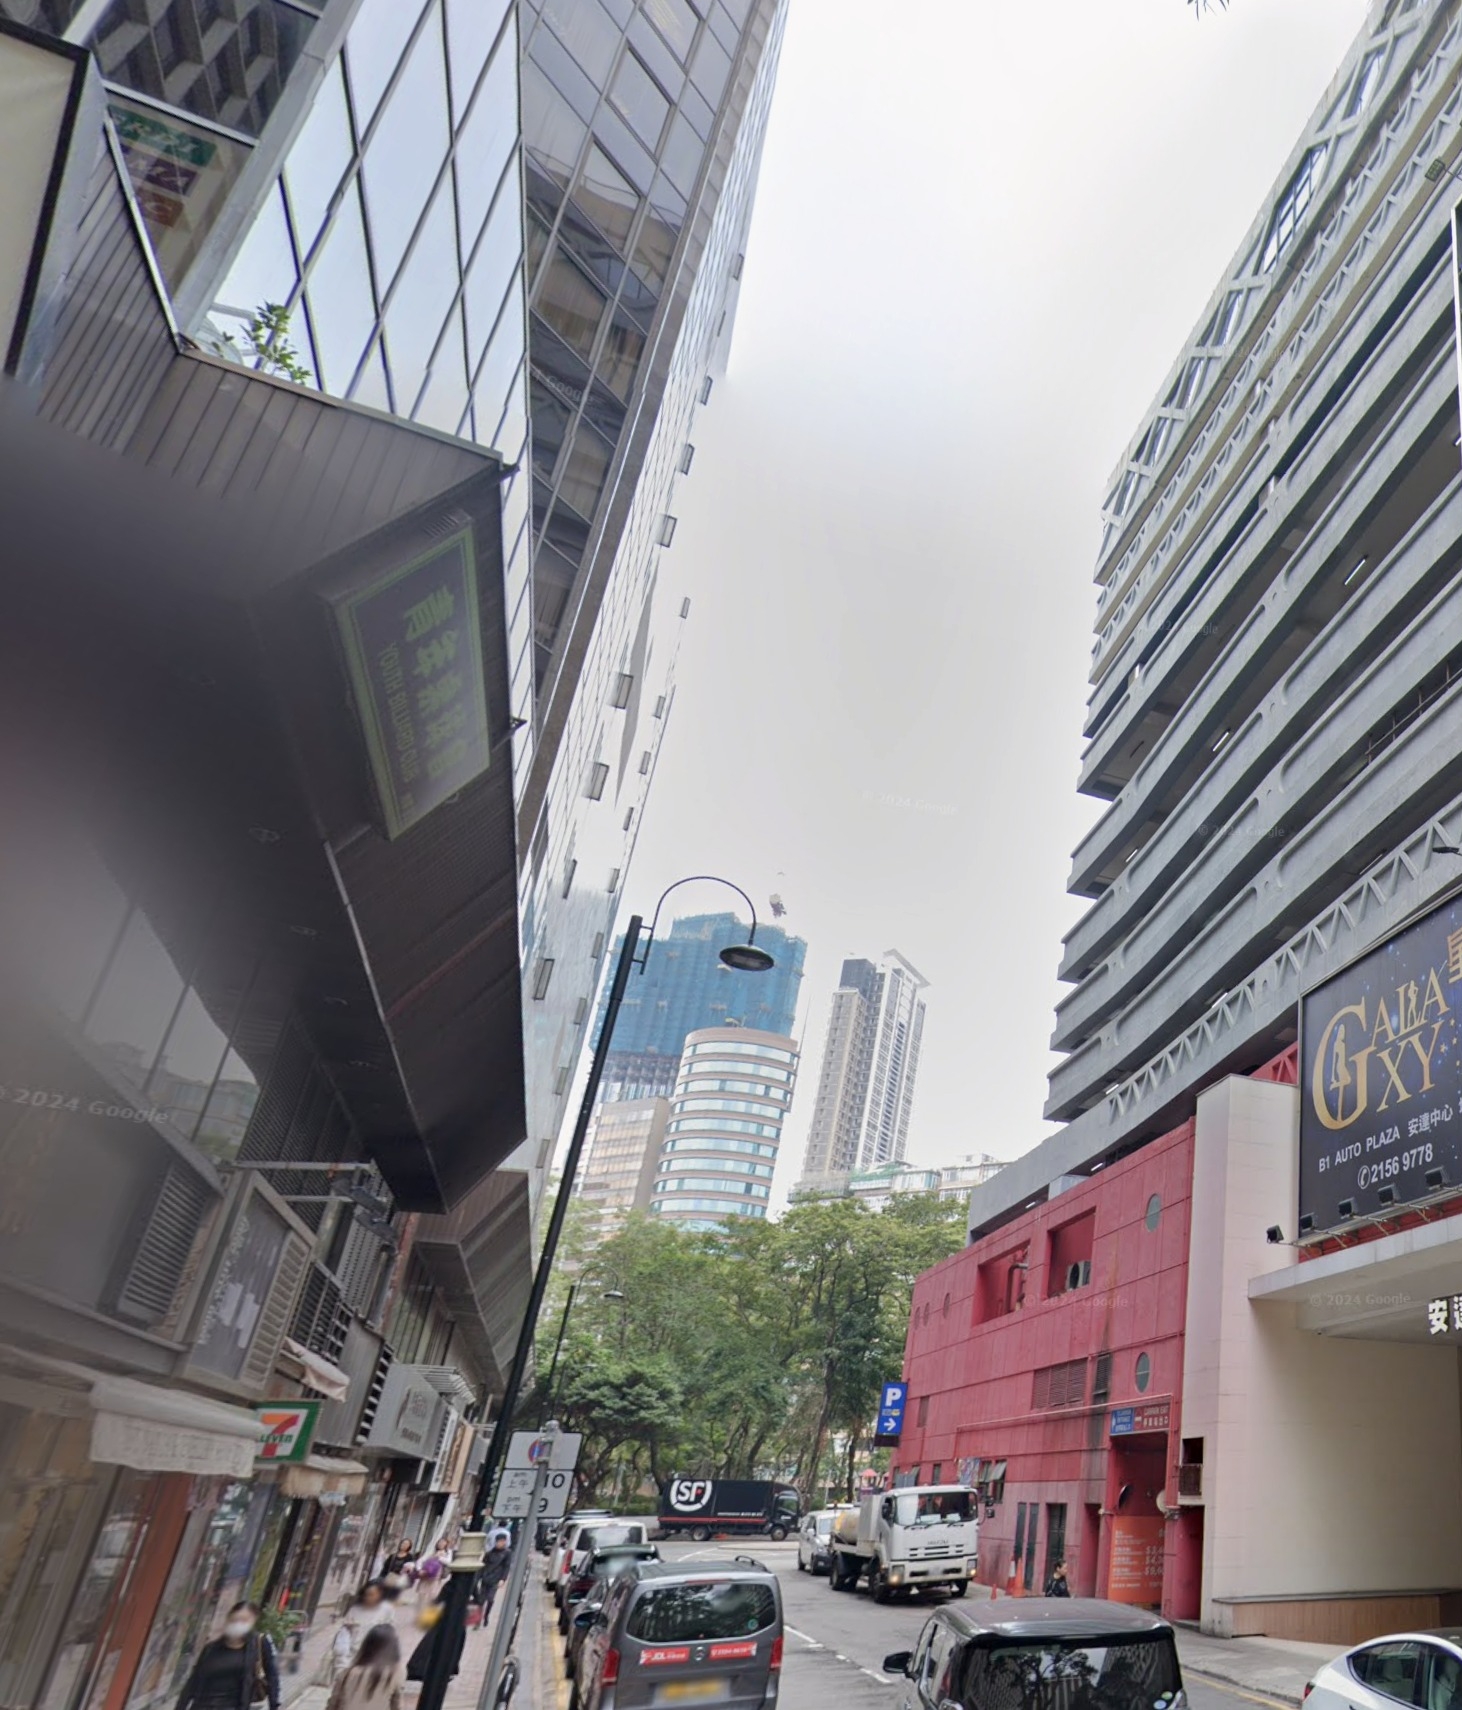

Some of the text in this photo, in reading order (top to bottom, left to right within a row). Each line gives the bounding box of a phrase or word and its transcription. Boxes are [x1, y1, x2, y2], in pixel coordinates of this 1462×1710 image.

[1318, 1155, 1331, 1173] B1
[1334, 1141, 1363, 1167] AUTO
[1366, 1125, 1401, 1153] PLAZA
[1408, 1103, 1454, 1138] 安達中心
[1371, 1142, 1434, 1184] 2156 9778
[885, 1387, 902, 1407] P
[507, 1478, 529, 1489] 上午
[677, 1480, 706, 1502] SF
[502, 1503, 522, 1513] 下午
